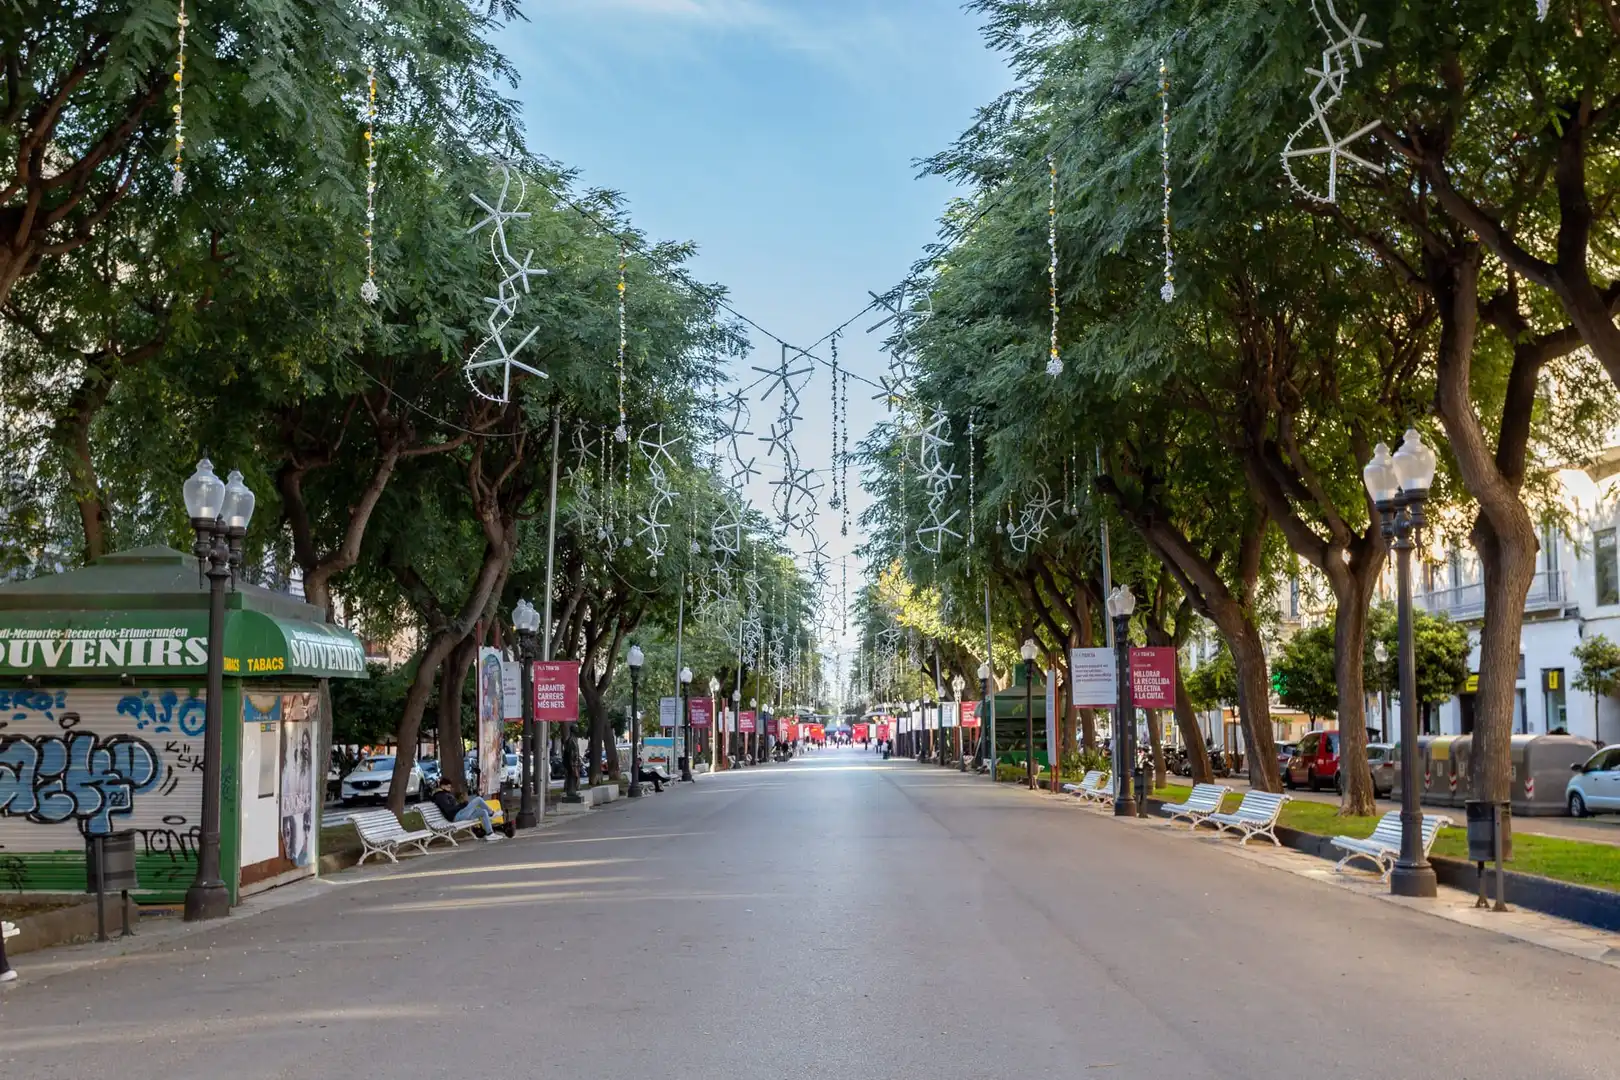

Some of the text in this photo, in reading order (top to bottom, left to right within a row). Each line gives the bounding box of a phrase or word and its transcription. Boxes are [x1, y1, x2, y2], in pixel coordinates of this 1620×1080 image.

[0, 637, 209, 668] UVENIRS
[291, 639, 363, 672] SOUVENIRS
[247, 657, 285, 672] TABACS
[538, 700, 550, 708] MÉS
